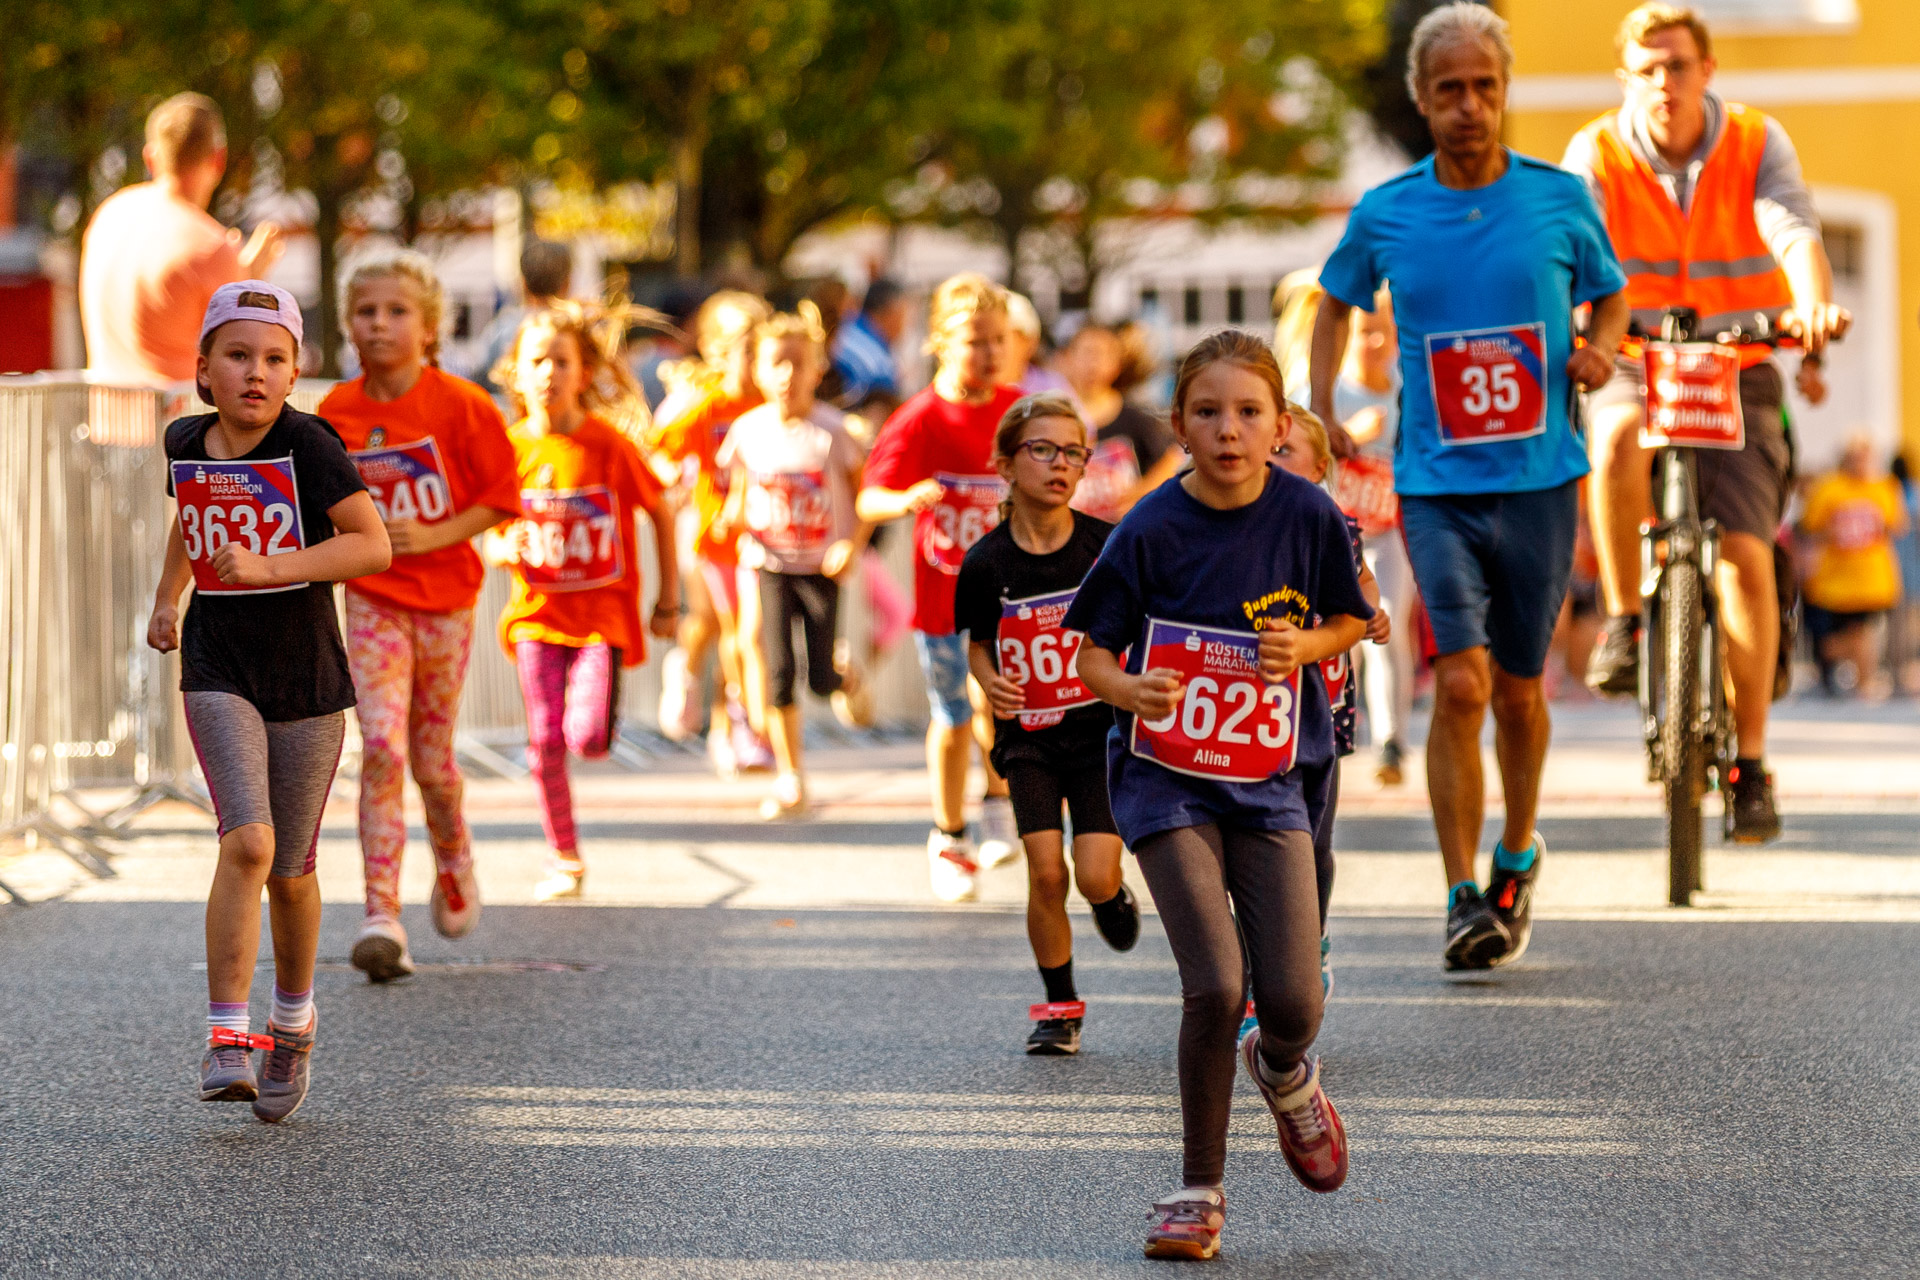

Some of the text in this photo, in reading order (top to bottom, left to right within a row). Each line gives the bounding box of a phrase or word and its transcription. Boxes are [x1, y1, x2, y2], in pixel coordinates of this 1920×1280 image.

[1460, 363, 1521, 416] 35
[208, 471, 249, 484] KÜSTEN
[209, 484, 263, 494] MARATHON
[182, 502, 297, 560] 3632
[1002, 630, 1085, 685] 362
[1205, 641, 1256, 660] KÜSTEN
[1203, 654, 1260, 671] MARATHO
[1056, 686, 1081, 700] Kira
[1193, 749, 1230, 767] Alina
